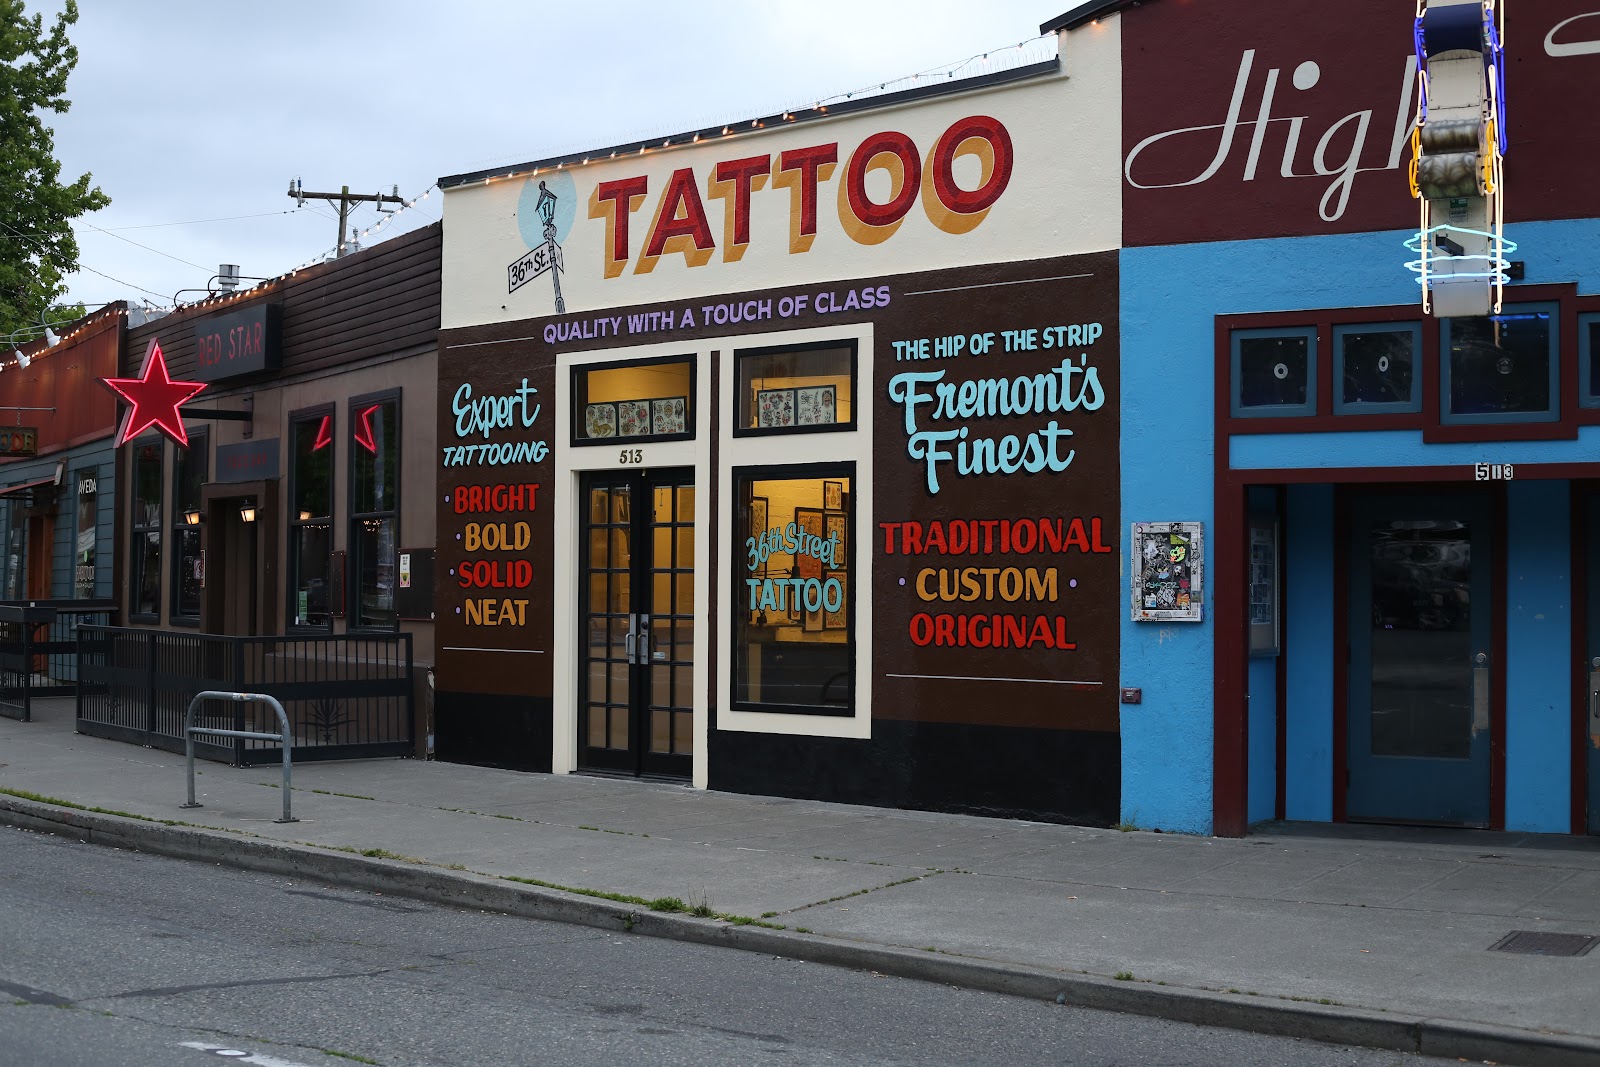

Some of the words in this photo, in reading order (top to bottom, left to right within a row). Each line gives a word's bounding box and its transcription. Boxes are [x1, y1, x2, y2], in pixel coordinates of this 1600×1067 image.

[588, 114, 1014, 279] TATTOO
[534, 249, 549, 272] St.
[543, 316, 623, 344] QUALITY
[627, 310, 675, 334] WITH
[679, 308, 696, 329] A
[701, 299, 772, 326] TOUCH
[778, 295, 809, 317] OF
[814, 285, 891, 314] CLASS
[198, 333, 223, 367] RED
[228, 321, 263, 360] STAR
[892, 338, 930, 361] THE
[934, 334, 966, 358] HIP
[969, 332, 995, 355] OF
[1000, 328, 1038, 352] THE
[1042, 322, 1103, 349] STRIP
[452, 378, 541, 439] Expert
[888, 354, 1105, 434] Fremont's
[443, 441, 549, 467] TATTOOING
[619, 449, 643, 464] 513
[906, 420, 1075, 494] Finest
[1475, 463, 1513, 480] 513
[77, 478, 97, 494] AVEDA
[454, 484, 540, 514] BRIGHT
[464, 521, 531, 551] BOLD
[746, 527, 783, 571] 36th
[784, 522, 840, 570] Street
[879, 517, 1111, 555] TRADITIONAL
[458, 560, 533, 588] SOLID
[915, 567, 1058, 602] CUSTOM
[465, 598, 529, 626] NEAT
[746, 578, 842, 612] TATTOO
[909, 613, 1077, 650] ORIGINAL
